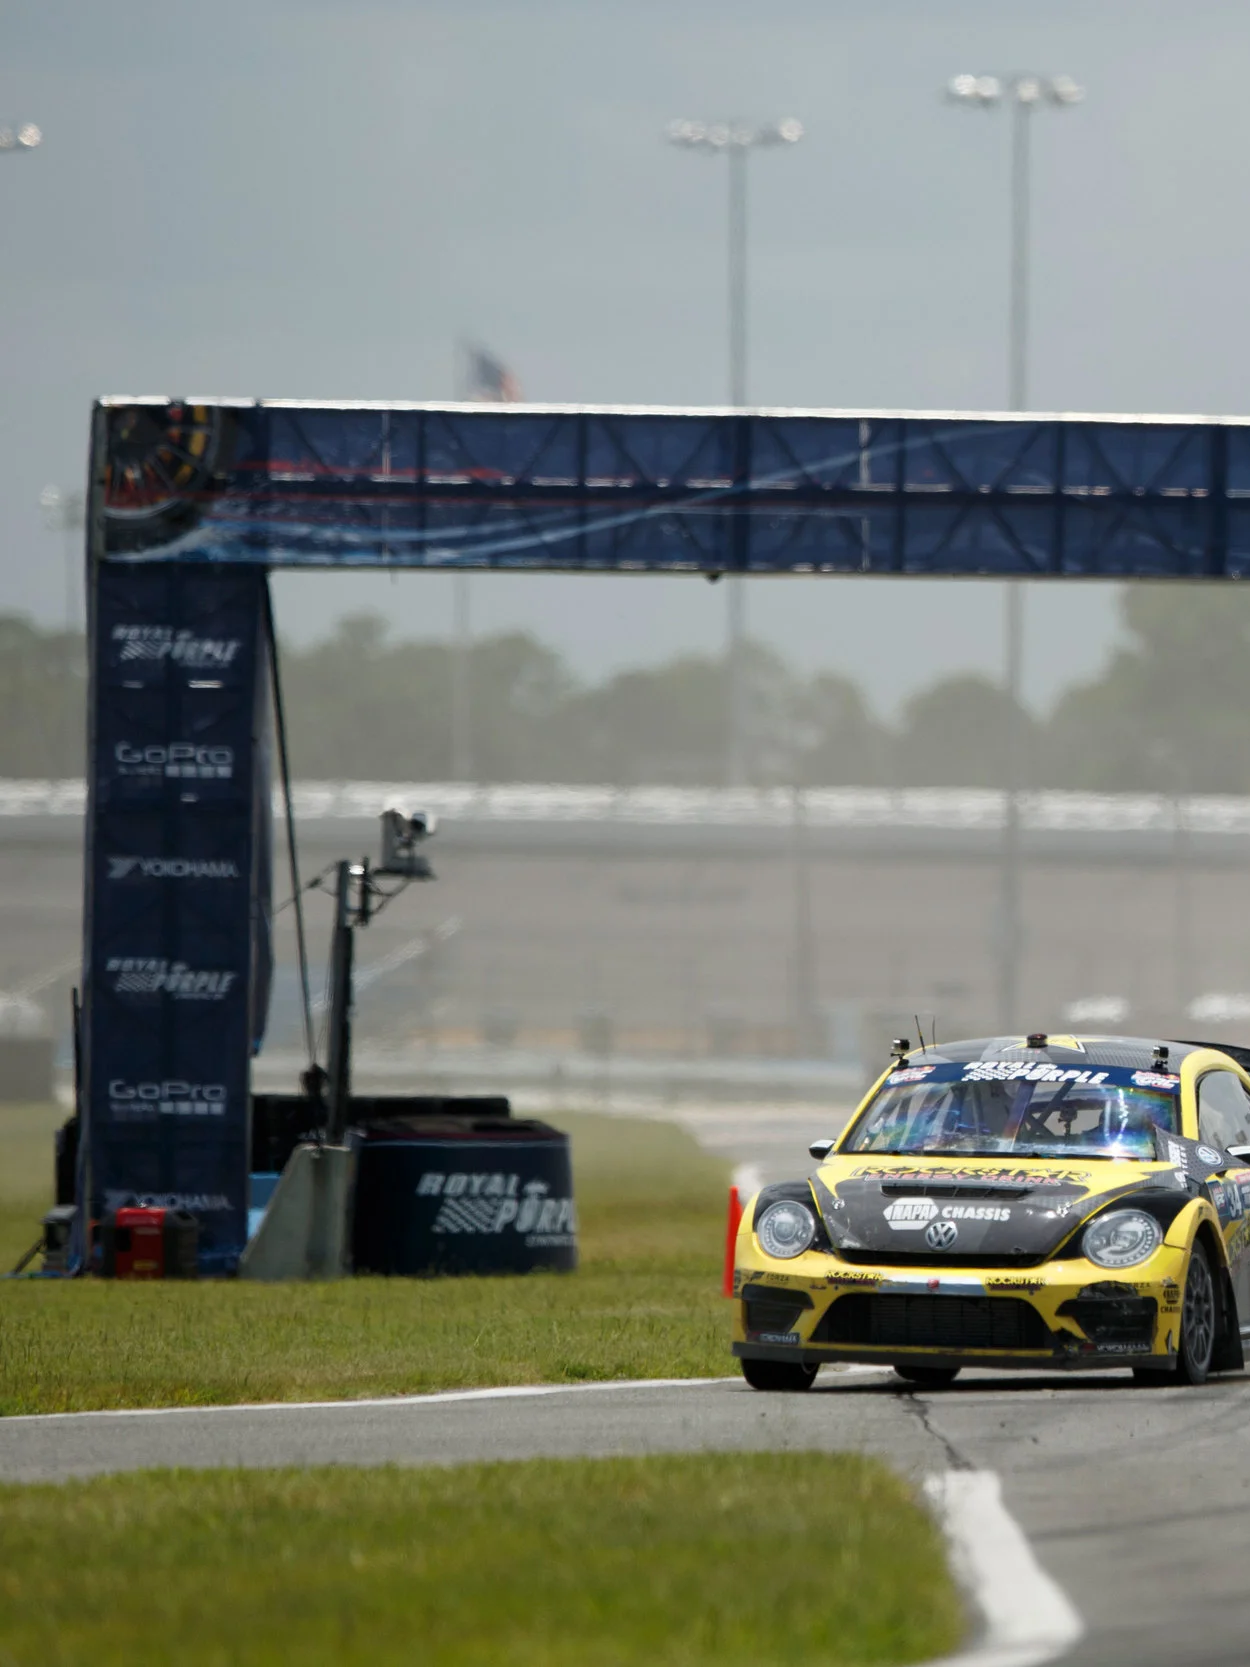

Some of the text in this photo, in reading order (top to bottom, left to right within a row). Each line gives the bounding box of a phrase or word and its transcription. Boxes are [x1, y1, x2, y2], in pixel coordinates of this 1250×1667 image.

[114, 741, 234, 764] GoPro
[962, 1061, 1037, 1070] ROYAL
[1009, 1067, 1110, 1084] PURPLE
[108, 1079, 228, 1100] GoPro
[851, 1166, 1092, 1181] ROCKSTAR
[865, 1173, 1061, 1185] ENERGY DRINK
[415, 1172, 520, 1196] ROYAL
[890, 1204, 1011, 1221] NAPA CHASSIS
[826, 1270, 883, 1281] ROCKSTAR
